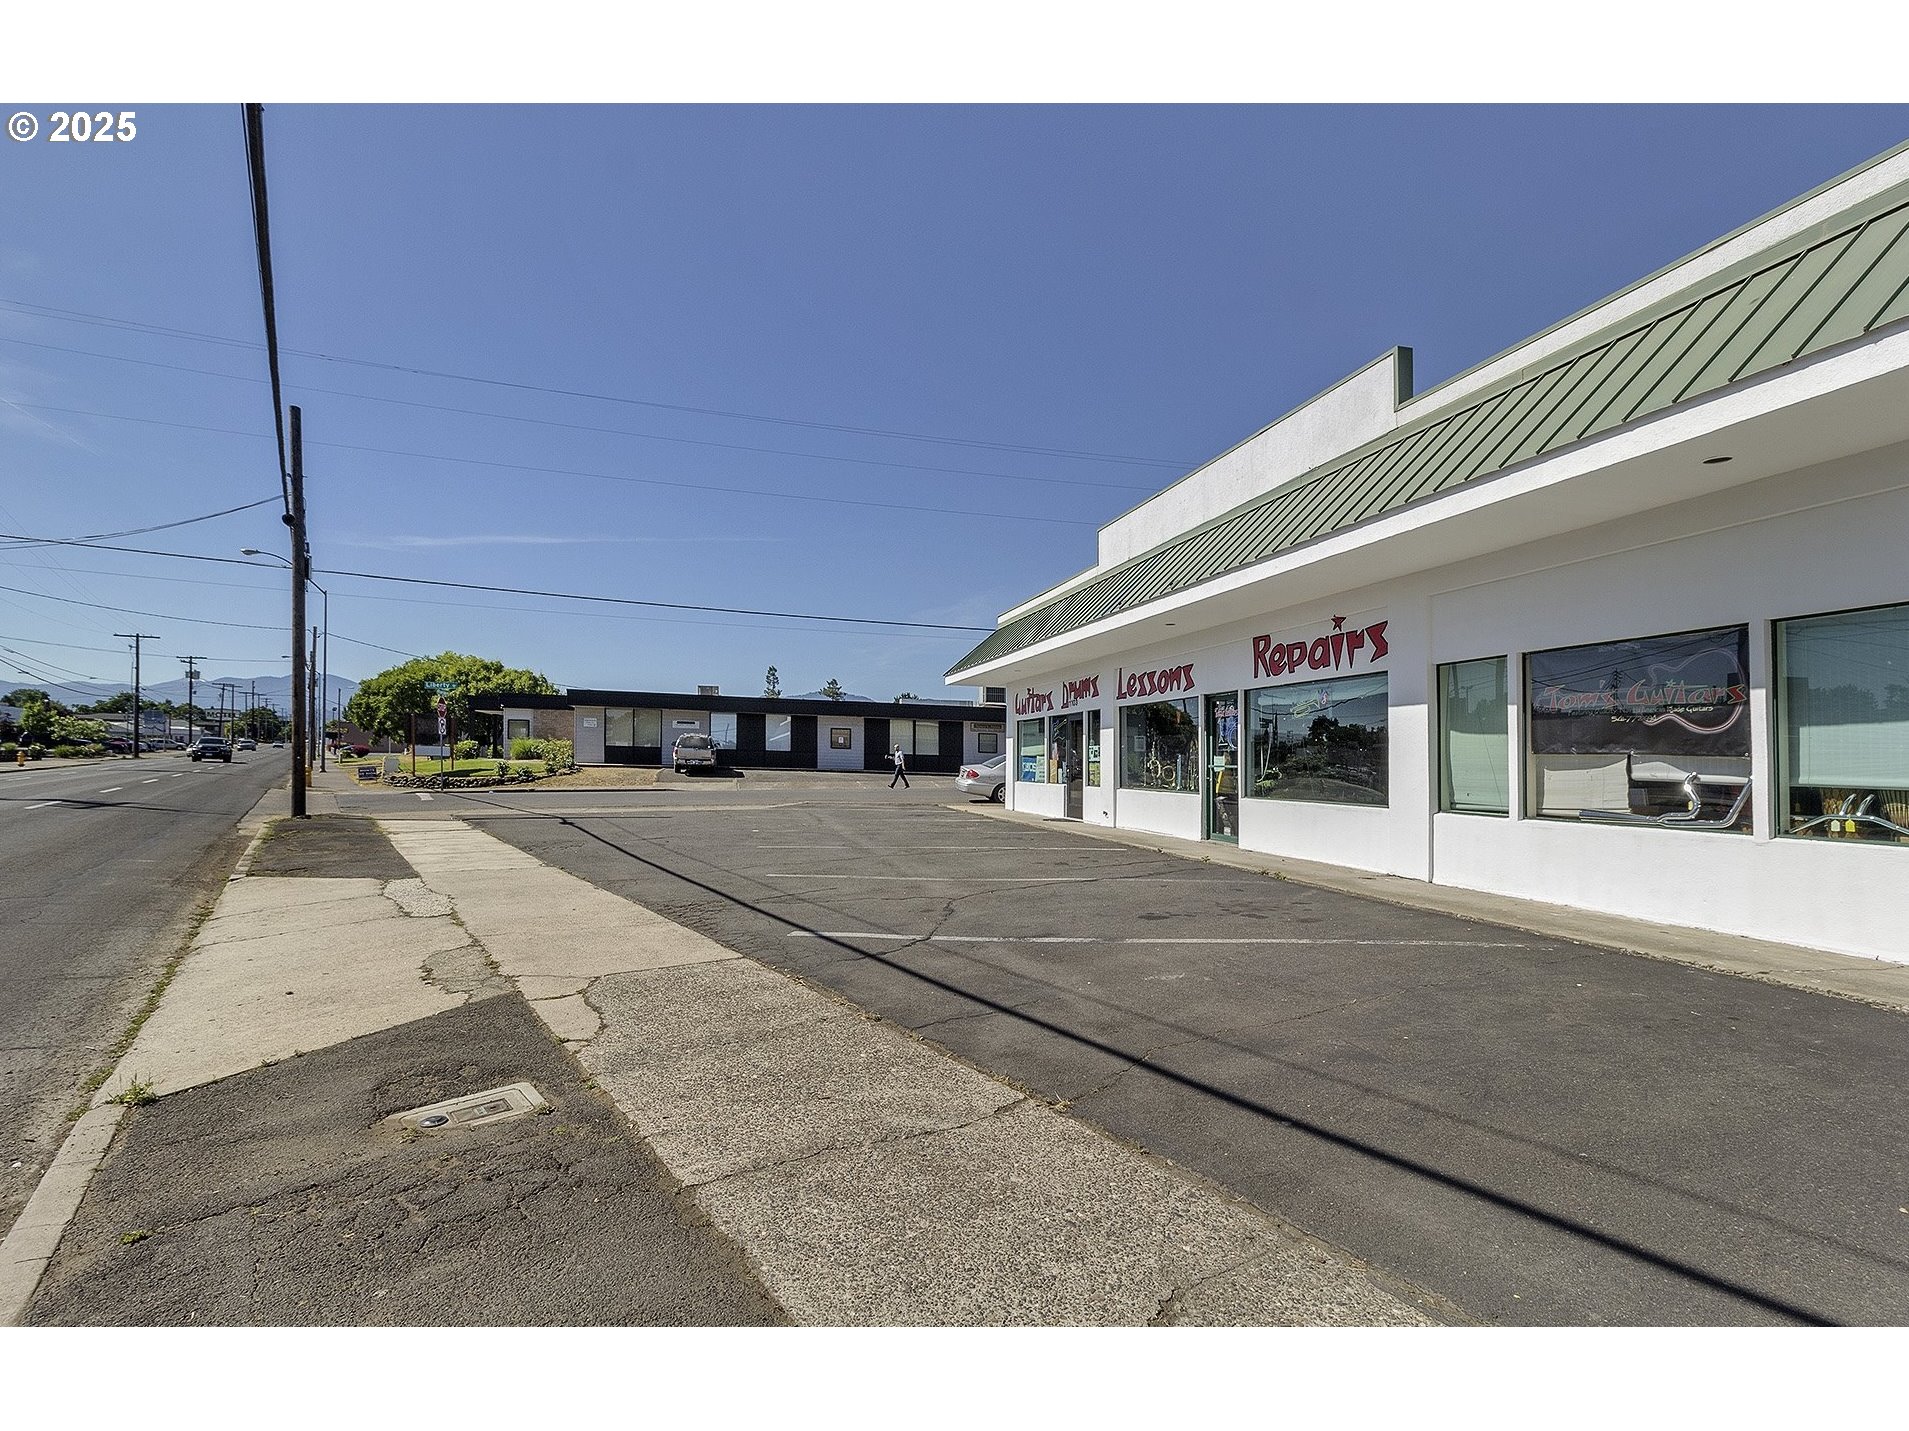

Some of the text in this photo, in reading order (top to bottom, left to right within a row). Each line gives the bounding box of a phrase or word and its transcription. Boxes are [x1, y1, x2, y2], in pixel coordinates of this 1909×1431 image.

[1252, 614, 1389, 679] Repairs
[425, 681, 450, 689] Liberty
[1015, 674, 1100, 716] Guitars Drums
[1116, 662, 1195, 700] Lessons
[1543, 680, 1619, 713] Tom's
[1626, 679, 1747, 705] Guitars
[1685, 705, 1714, 714] Guitars
